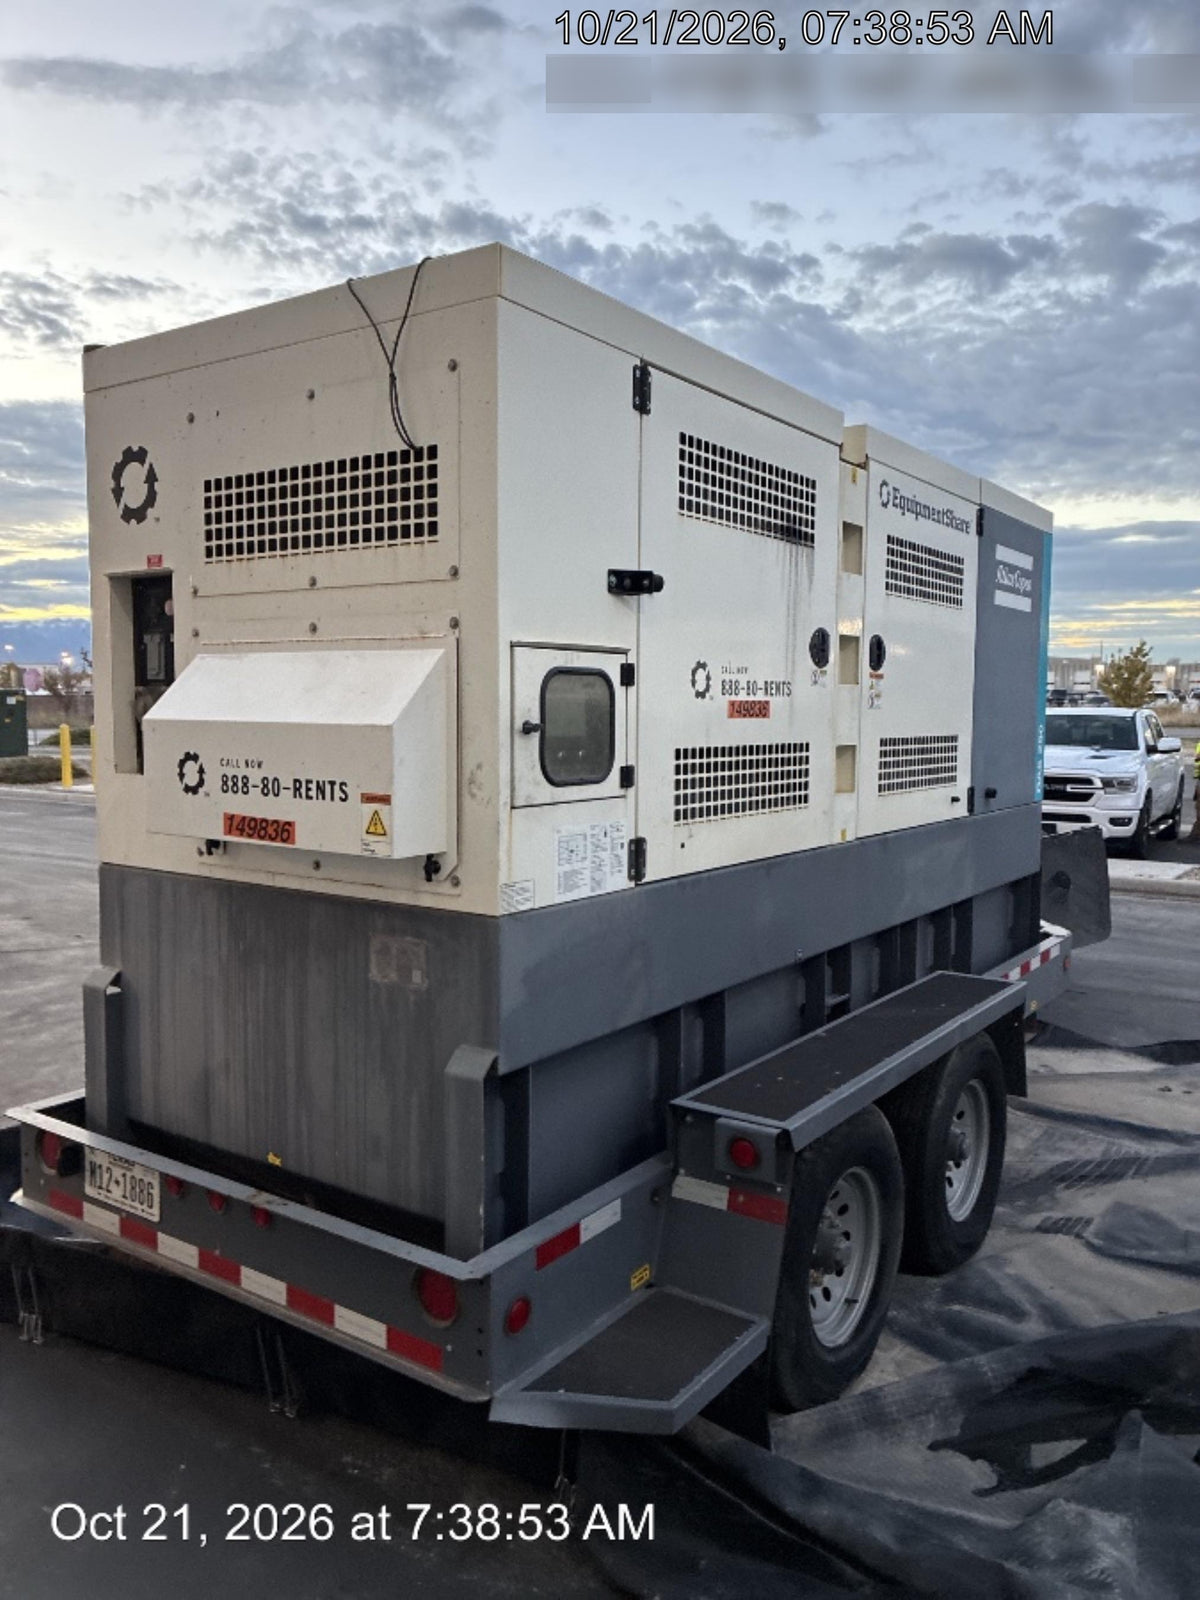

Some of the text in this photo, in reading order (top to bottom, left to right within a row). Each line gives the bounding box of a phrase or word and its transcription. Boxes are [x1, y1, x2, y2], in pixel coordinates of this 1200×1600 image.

[892, 486, 971, 534] EquipmentShare
[220, 758, 264, 769] CALL NOW
[220, 774, 349, 802] 888-80-RENTS
[226, 813, 292, 843] 149836
